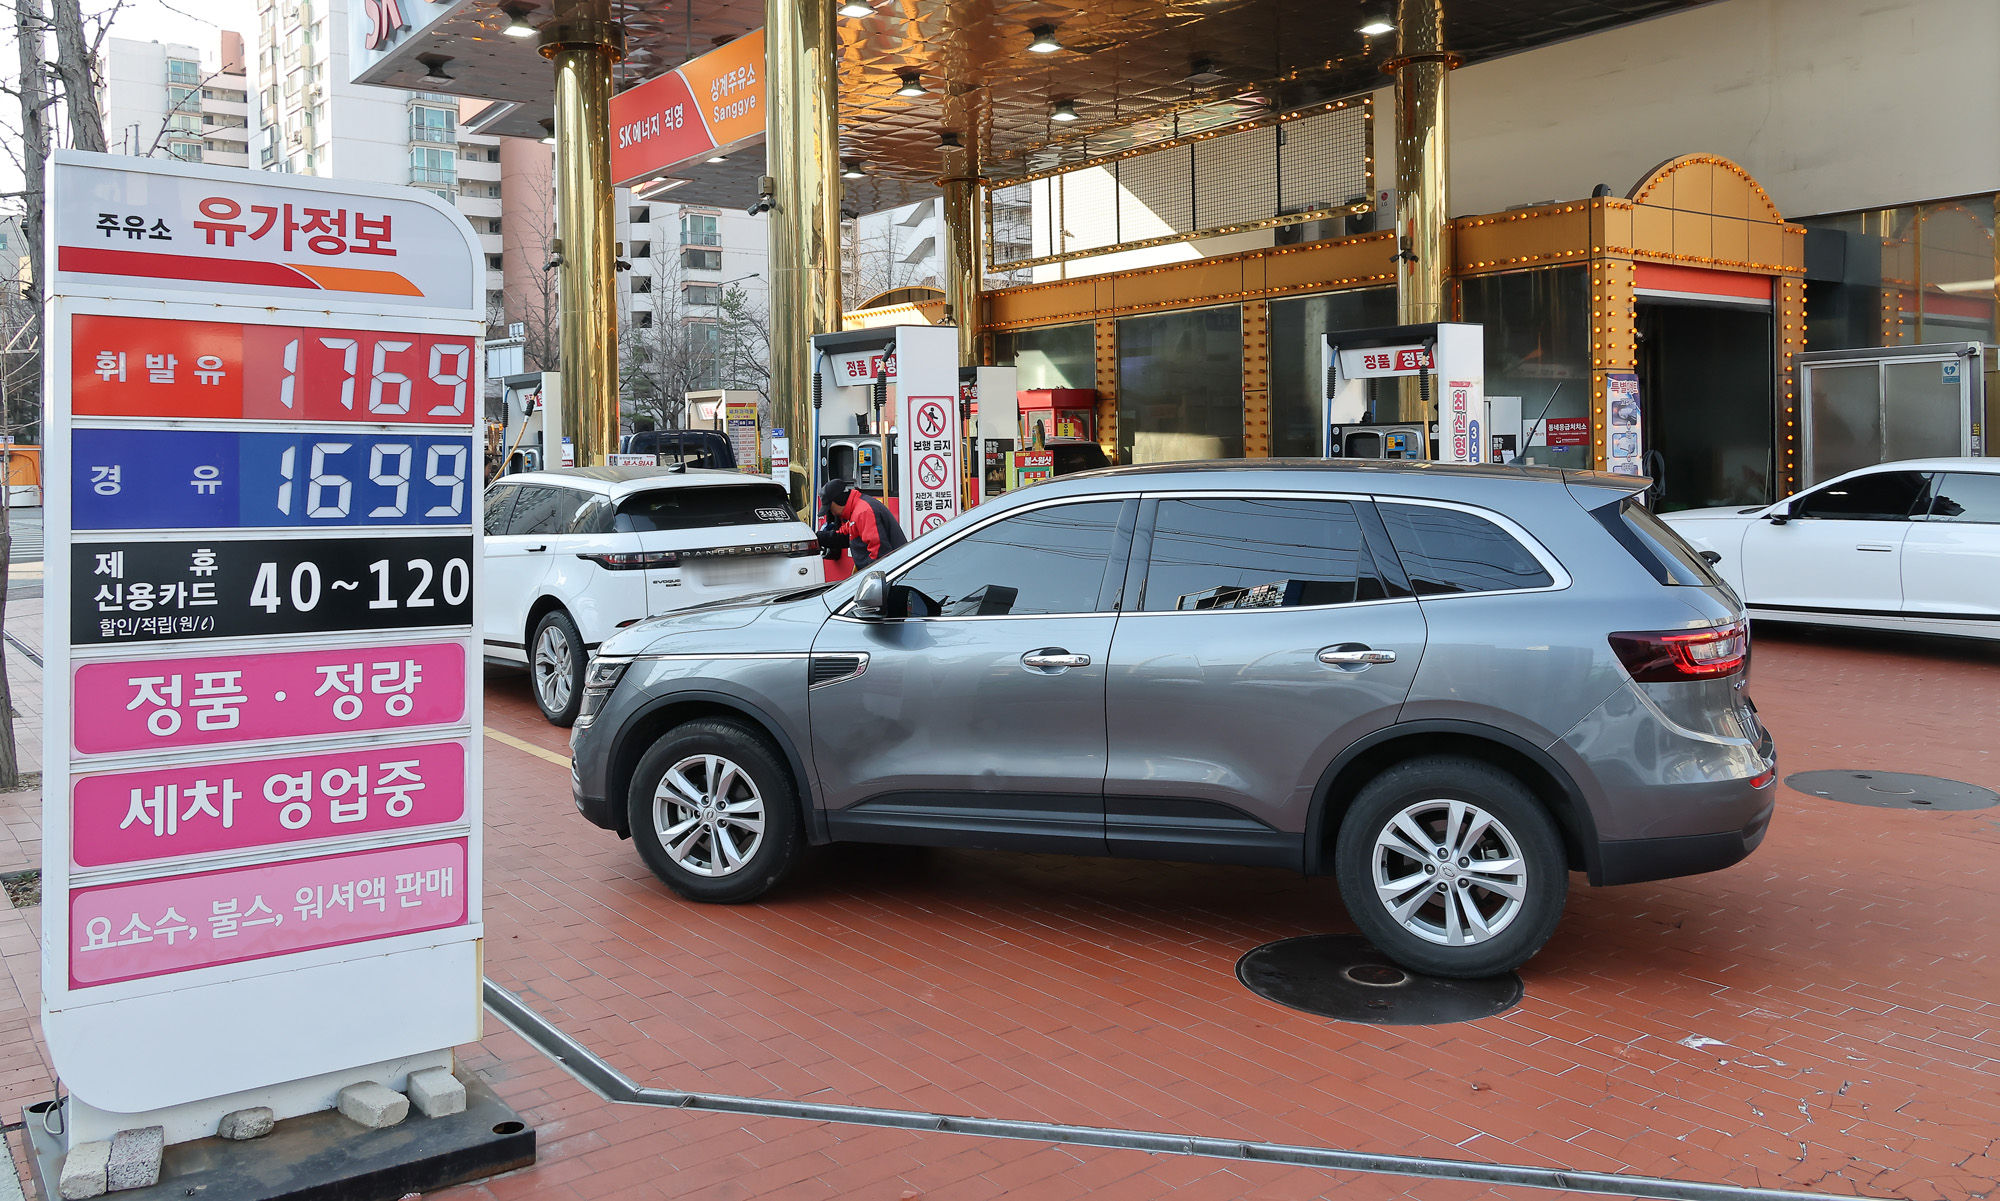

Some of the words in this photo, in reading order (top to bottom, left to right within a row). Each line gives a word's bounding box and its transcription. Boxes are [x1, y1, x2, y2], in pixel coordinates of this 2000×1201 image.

[711, 63, 756, 102] 상계주유소
[619, 112, 660, 149] SK에너지
[664, 103, 684, 131] 직영
[714, 95, 756, 123] Sanggye
[96, 213, 172, 241] 주유소
[193, 197, 397, 257] 유가정보
[280, 338, 472, 416] 1769
[846, 359, 868, 377] 정품
[1364, 354, 1390, 369] 정품
[1548, 423, 1587, 431] 동네응급처치소
[913, 440, 931, 451] 보행
[934, 440, 951, 450] 금지
[277, 443, 468, 519] 1699
[915, 500, 933, 511] 통행
[935, 499, 952, 510] 금지
[682, 548, 736, 557] RANGE
[744, 544, 790, 553] ROVER
[94, 582, 219, 612] 신용카드
[126, 670, 248, 736] 정품
[314, 659, 422, 721] 정량
[120, 778, 243, 837] 세차
[263, 759, 426, 830] 영업중
[80, 907, 198, 953] 요소수,
[208, 895, 285, 939] 불스,
[293, 876, 386, 921] 워셔액
[395, 866, 454, 908] 판매
